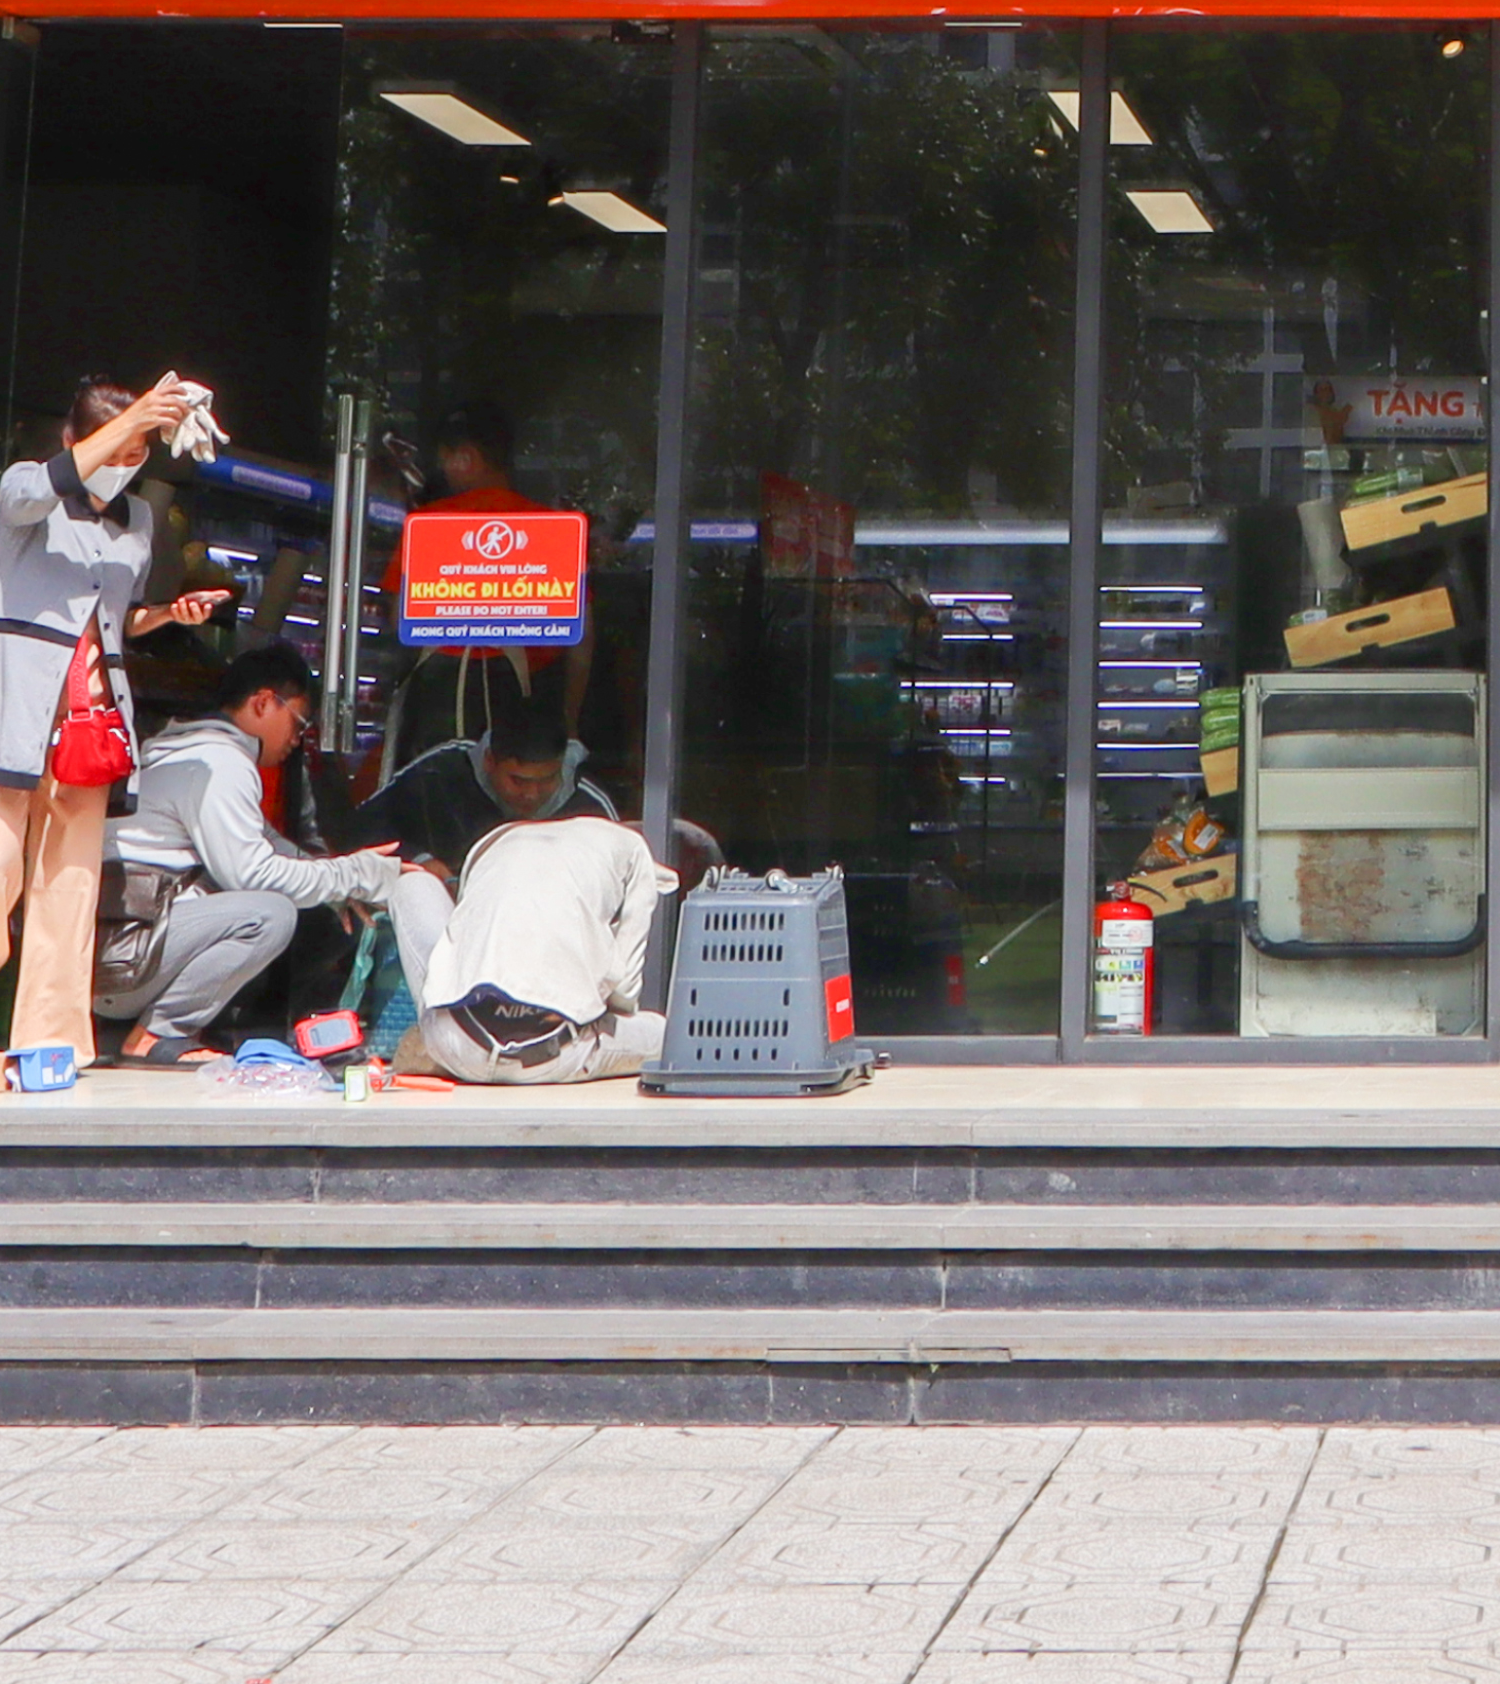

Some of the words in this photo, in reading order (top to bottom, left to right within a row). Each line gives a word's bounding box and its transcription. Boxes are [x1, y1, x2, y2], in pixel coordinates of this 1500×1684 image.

[1367, 382, 1464, 424] TẶNG
[411, 579, 476, 598] KHÔNG
[481, 582, 498, 598] ĐI
[502, 576, 532, 598] LỐI
[537, 577, 575, 598] NÀY
[435, 606, 472, 615] PLEASE
